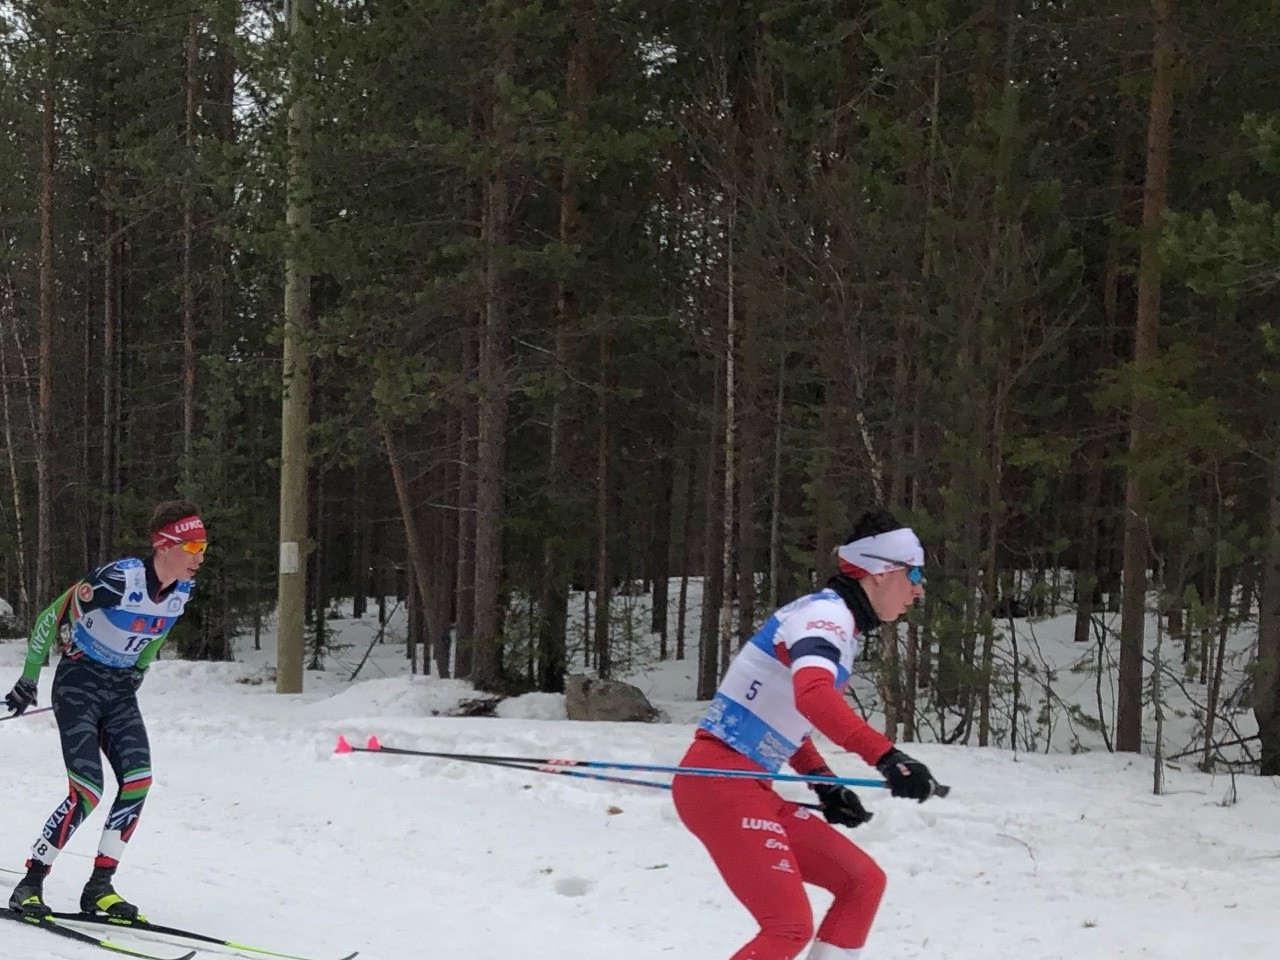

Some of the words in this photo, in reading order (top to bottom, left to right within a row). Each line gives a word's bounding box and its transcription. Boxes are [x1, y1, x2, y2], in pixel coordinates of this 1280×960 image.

[31, 608, 58, 654] KAZAN
[745, 680, 762, 701] 5
[741, 816, 787, 837] LUKO
[32, 837, 49, 857] 18
